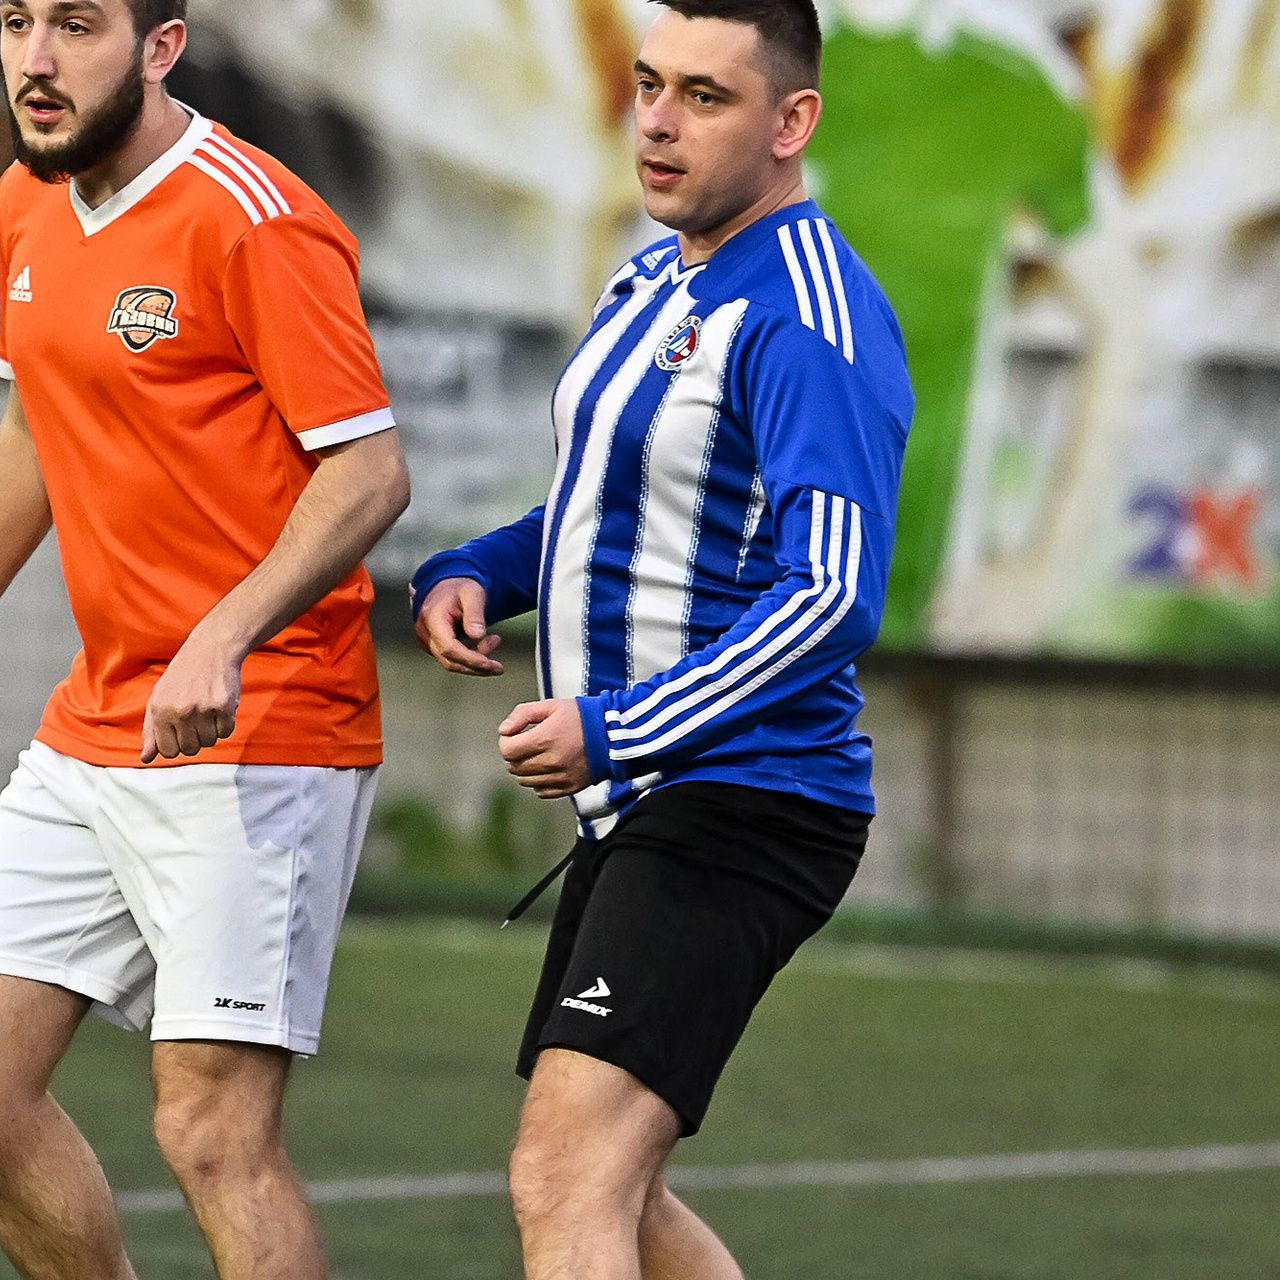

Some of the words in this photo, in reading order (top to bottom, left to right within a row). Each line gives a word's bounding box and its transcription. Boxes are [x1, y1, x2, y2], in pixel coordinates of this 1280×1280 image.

[214, 997, 233, 1009] 2K
[232, 1001, 267, 1012] SPORT
[560, 997, 613, 1017] DEMIX
